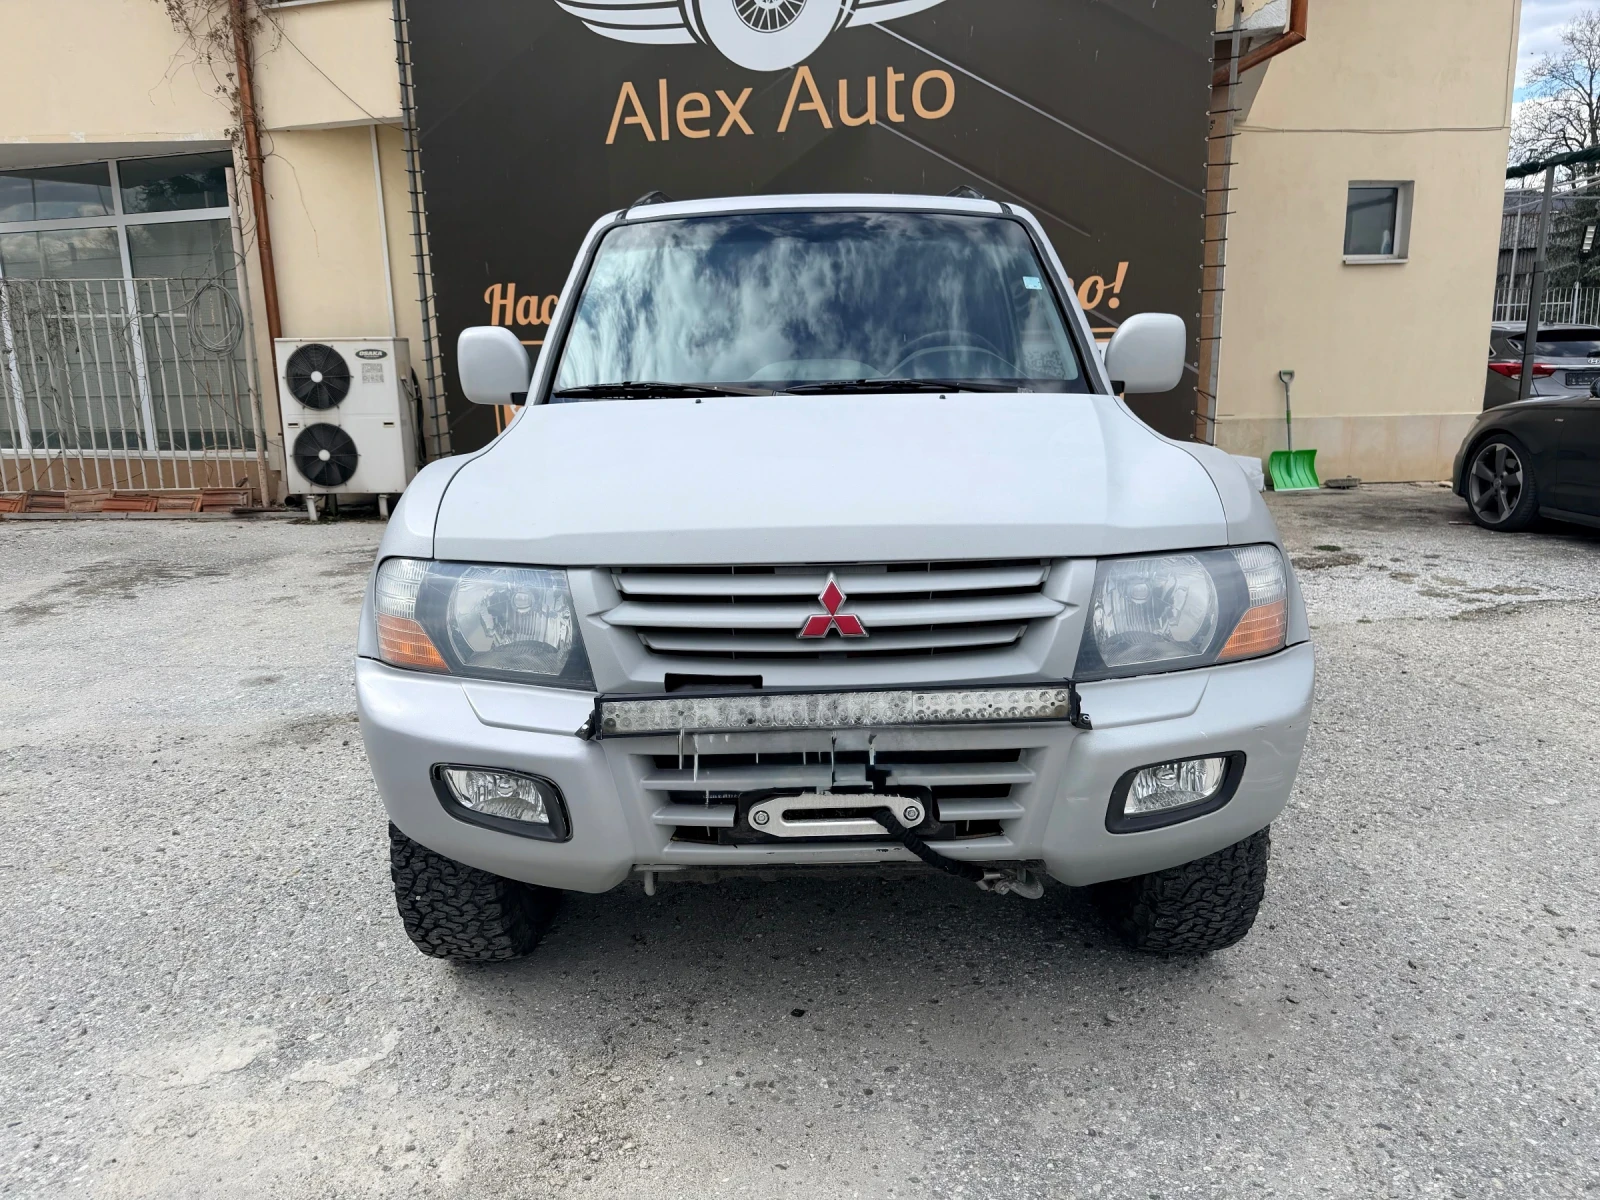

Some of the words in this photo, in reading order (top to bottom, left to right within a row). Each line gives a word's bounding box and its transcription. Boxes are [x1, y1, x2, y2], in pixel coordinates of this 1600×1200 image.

[605, 78, 754, 145] Alex
[777, 65, 955, 133] Auto
[1069, 261, 1129, 311] о!
